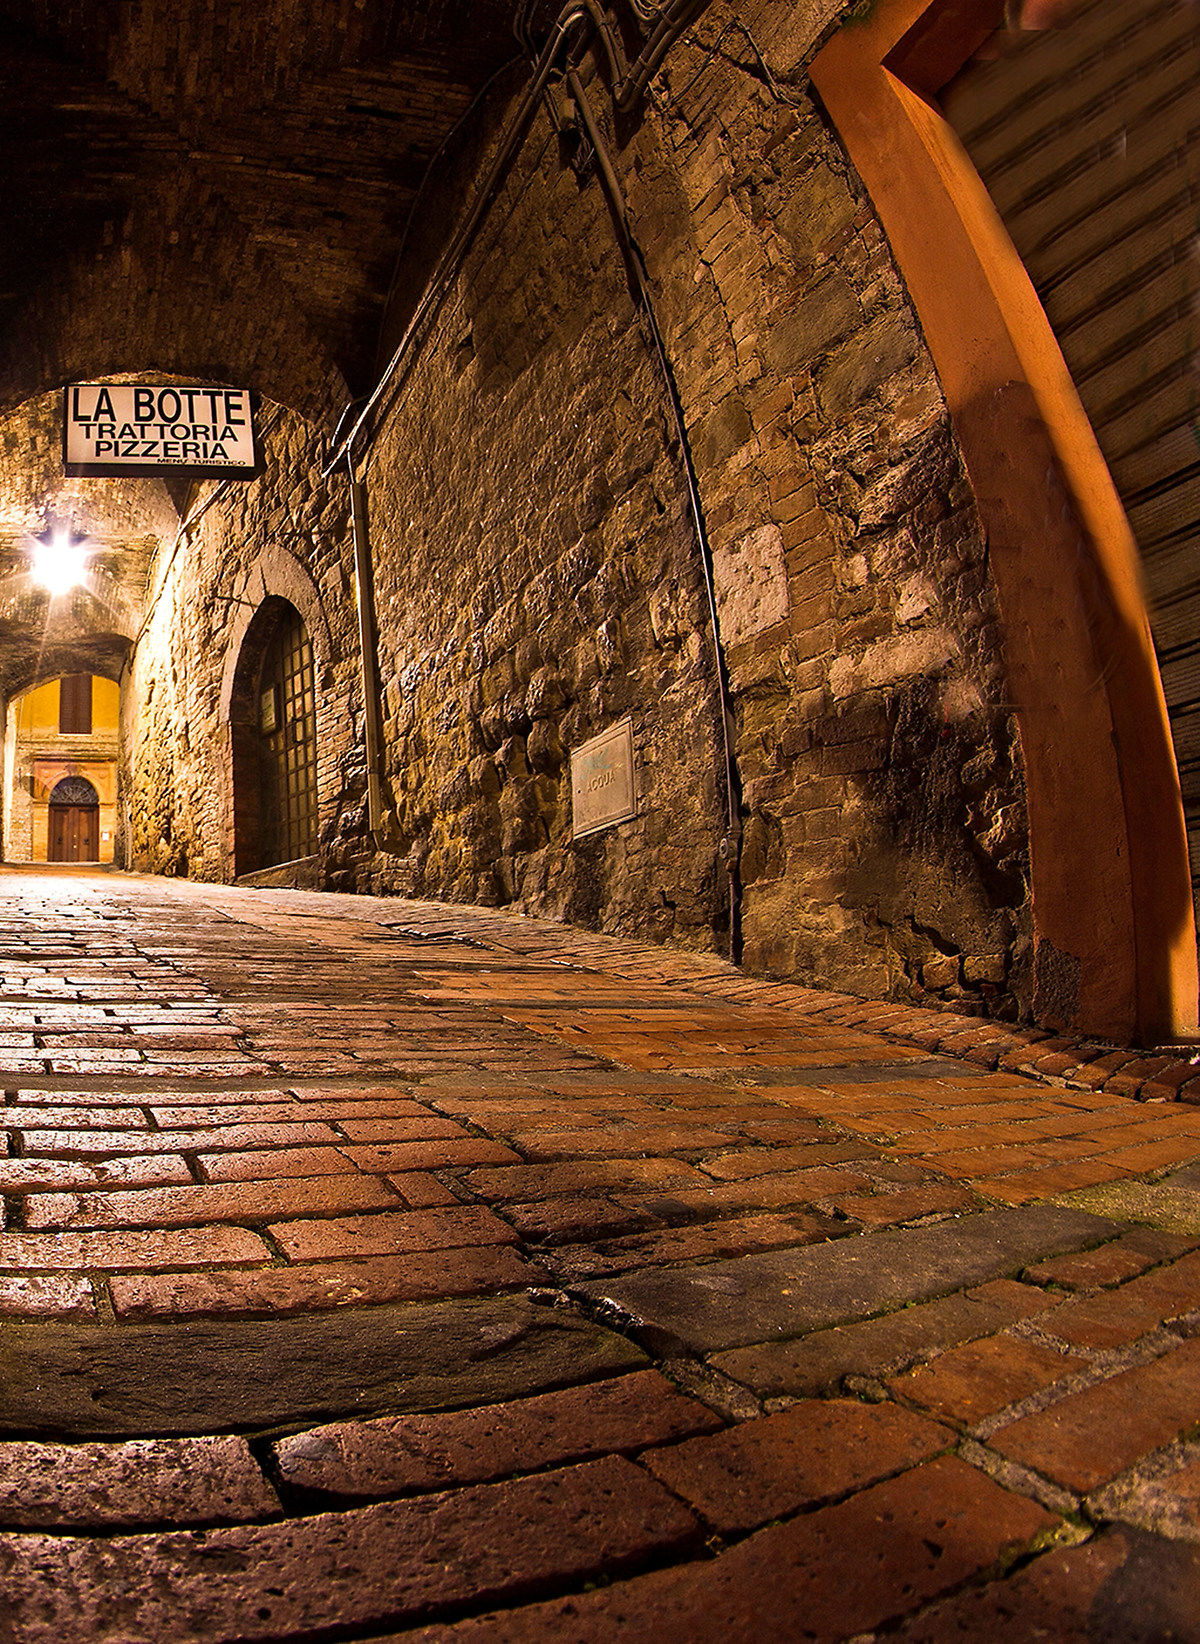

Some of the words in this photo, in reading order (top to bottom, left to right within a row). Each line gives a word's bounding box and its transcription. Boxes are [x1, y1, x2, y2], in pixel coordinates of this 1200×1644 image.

[72, 387, 116, 422] LA
[134, 388, 246, 426] BOTTE
[78, 423, 238, 442] TRATTORIA
[95, 440, 229, 459] PIZZERIA
[587, 770, 616, 793] ACQUA
